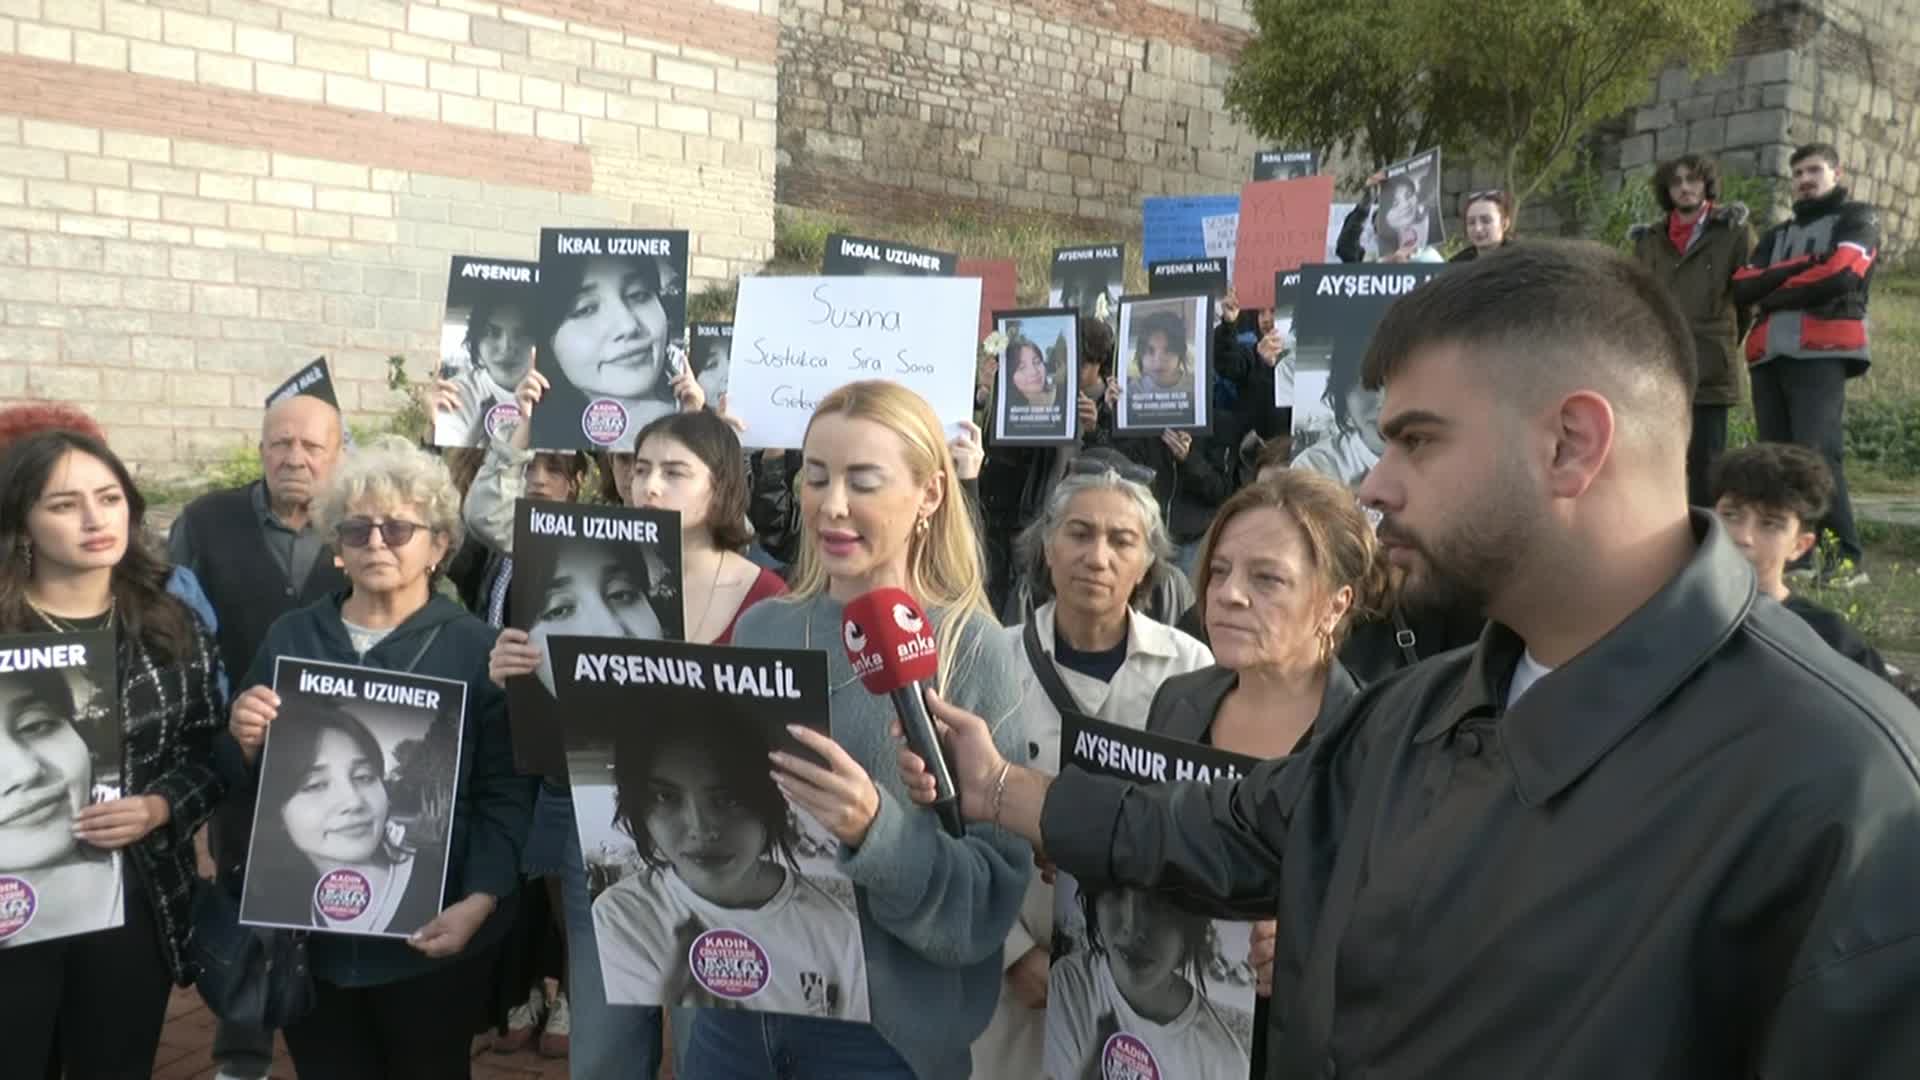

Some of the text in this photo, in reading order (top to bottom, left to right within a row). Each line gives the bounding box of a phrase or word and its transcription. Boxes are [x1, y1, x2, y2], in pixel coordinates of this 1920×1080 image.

[557, 233, 671, 256] İKBAL UZUNER
[841, 239, 940, 271] İKBAL UZUNER
[461, 263, 531, 282] AYŞENUR
[1283, 274, 1300, 286] AY
[1316, 274, 1417, 299] AYŞENUR
[808, 283, 901, 332] Susma
[530, 507, 659, 543] İKBAL UZUNER
[897, 632, 935, 657] anka
[299, 669, 441, 709] İKBAL UZUNER
[574, 653, 801, 698] AYŞENUR HALİL
[1073, 730, 1167, 783] AYŞENUR
[705, 937, 748, 950] KADIN
